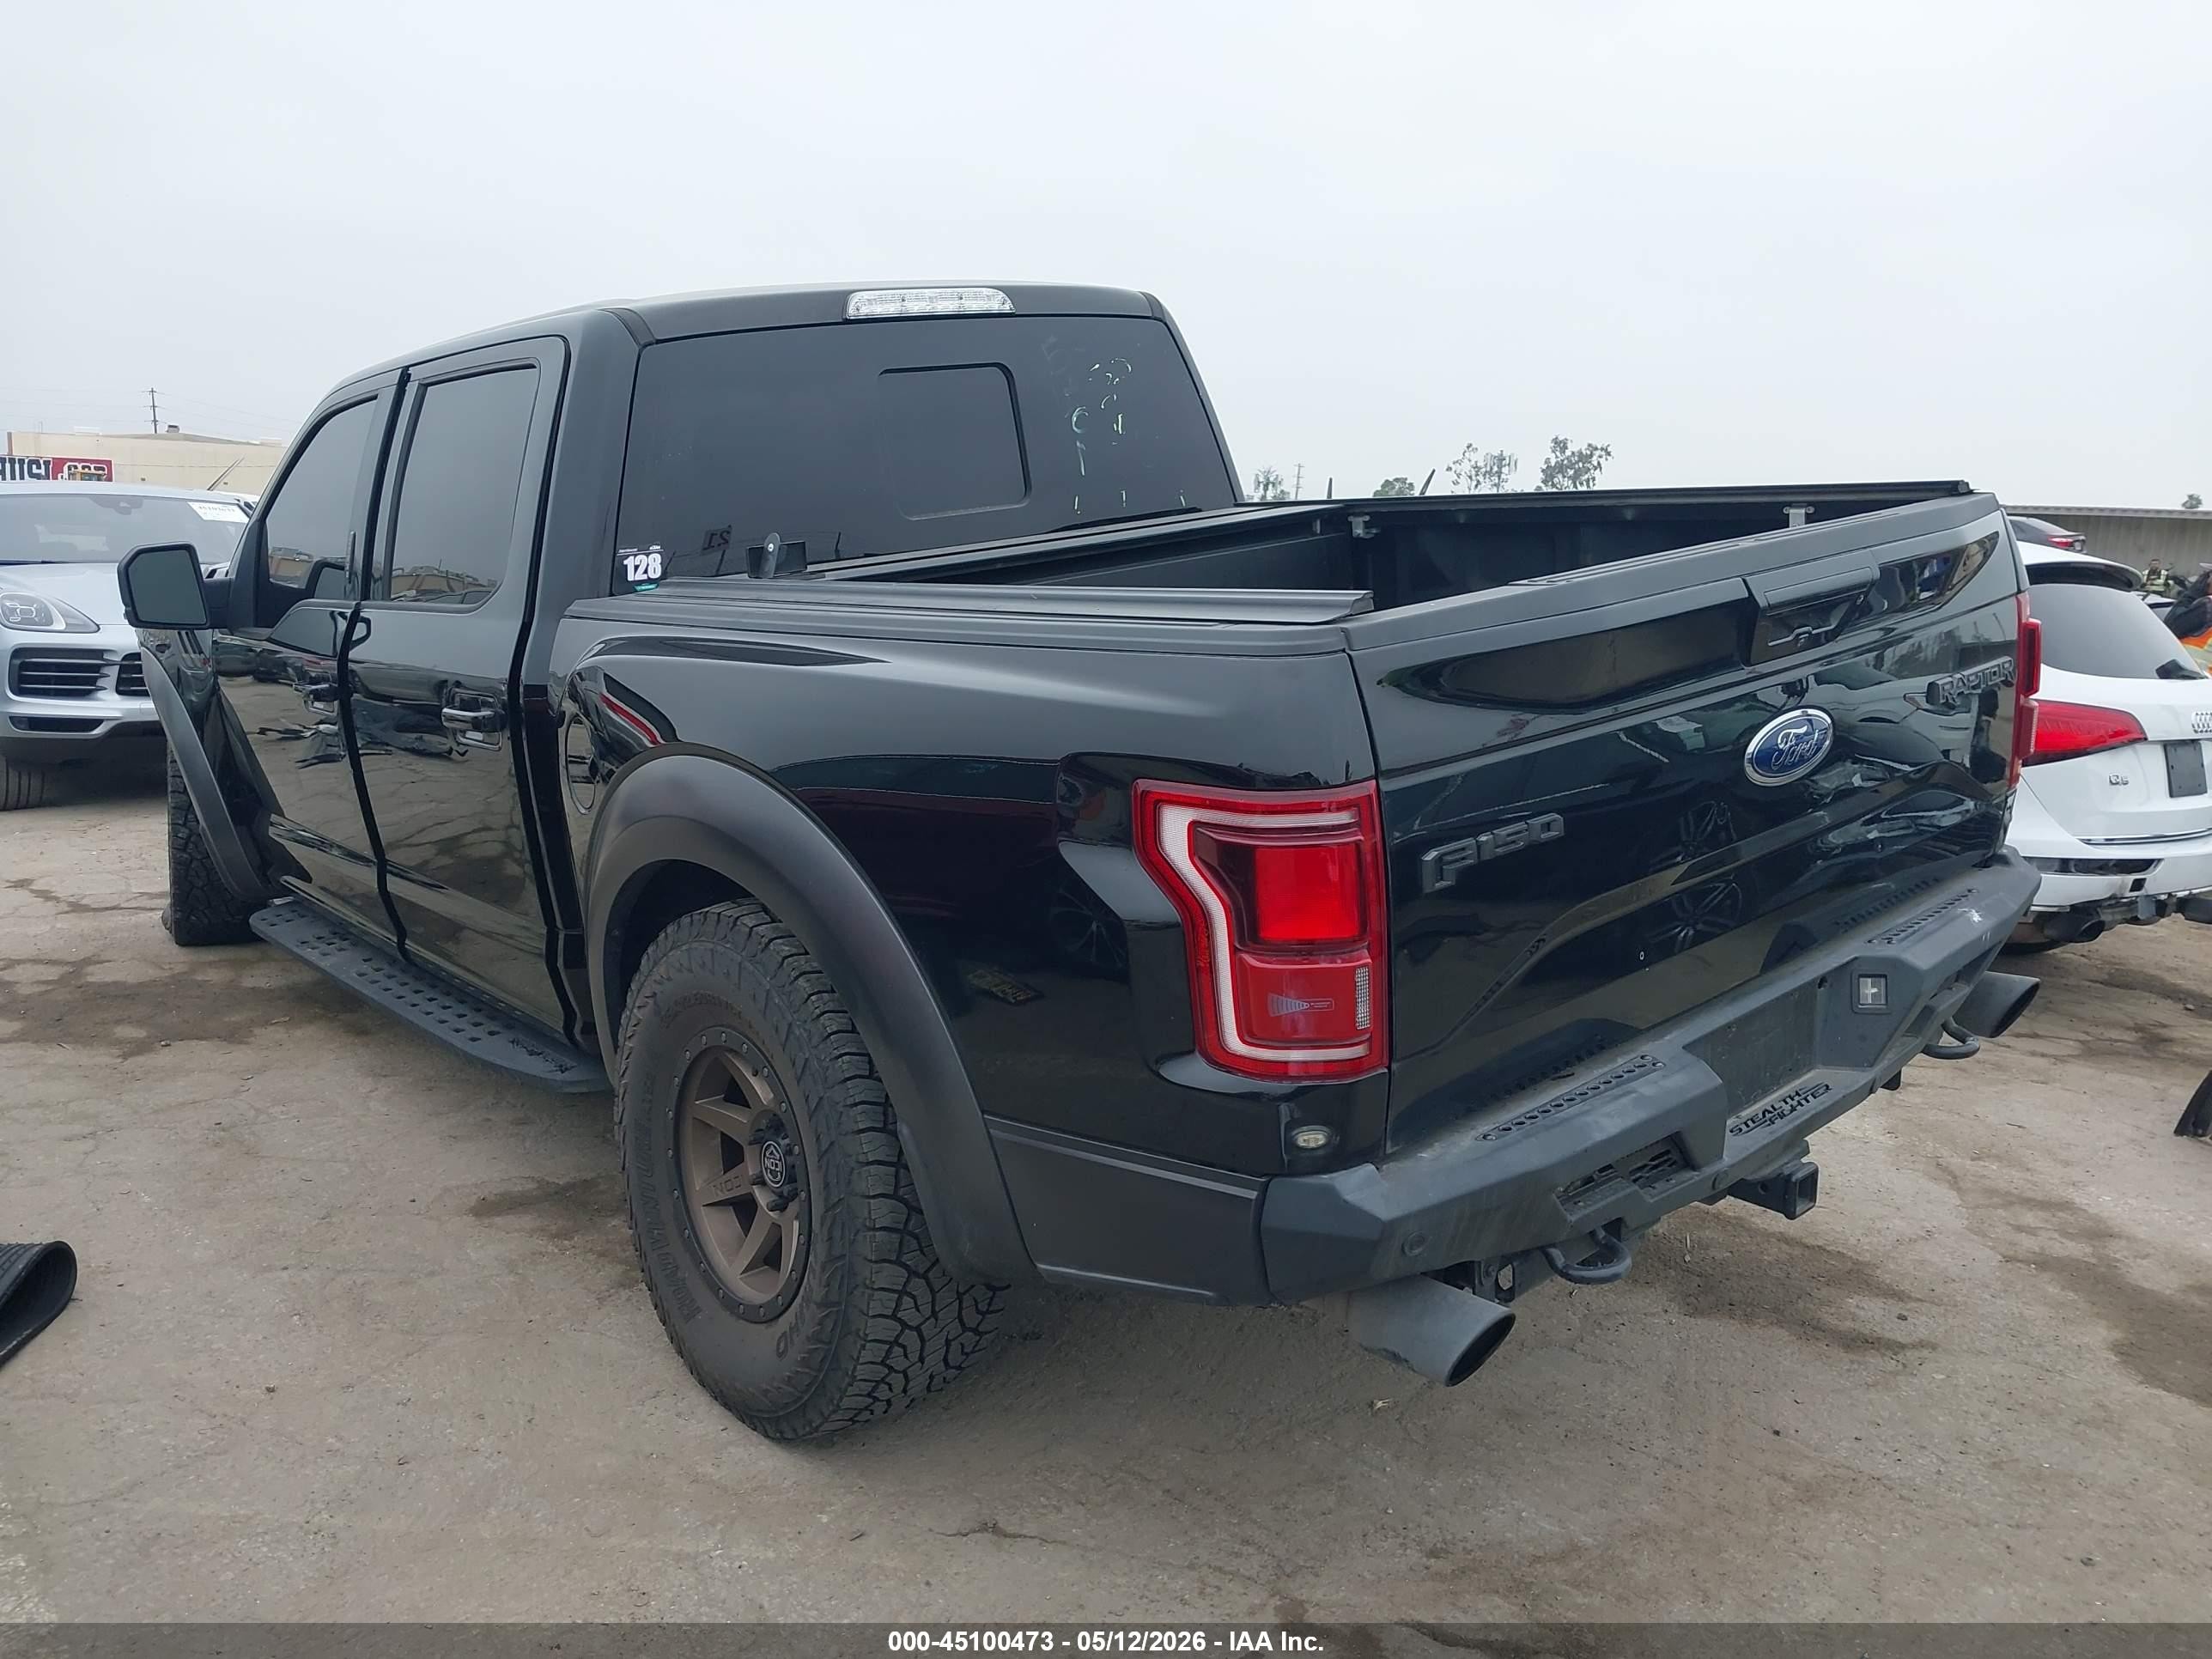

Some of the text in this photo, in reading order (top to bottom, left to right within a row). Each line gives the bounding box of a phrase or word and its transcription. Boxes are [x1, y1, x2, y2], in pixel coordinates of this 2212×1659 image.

[623, 553, 662, 581] 128
[1936, 656, 2014, 706] RAPTOR
[1771, 725, 1828, 771] Ford
[1729, 1085, 1808, 1137] STEALTH
[1760, 1083, 1833, 1128] FIGHTER
[712, 1175, 744, 1197] ICON
[763, 1157, 782, 1174] ICON
